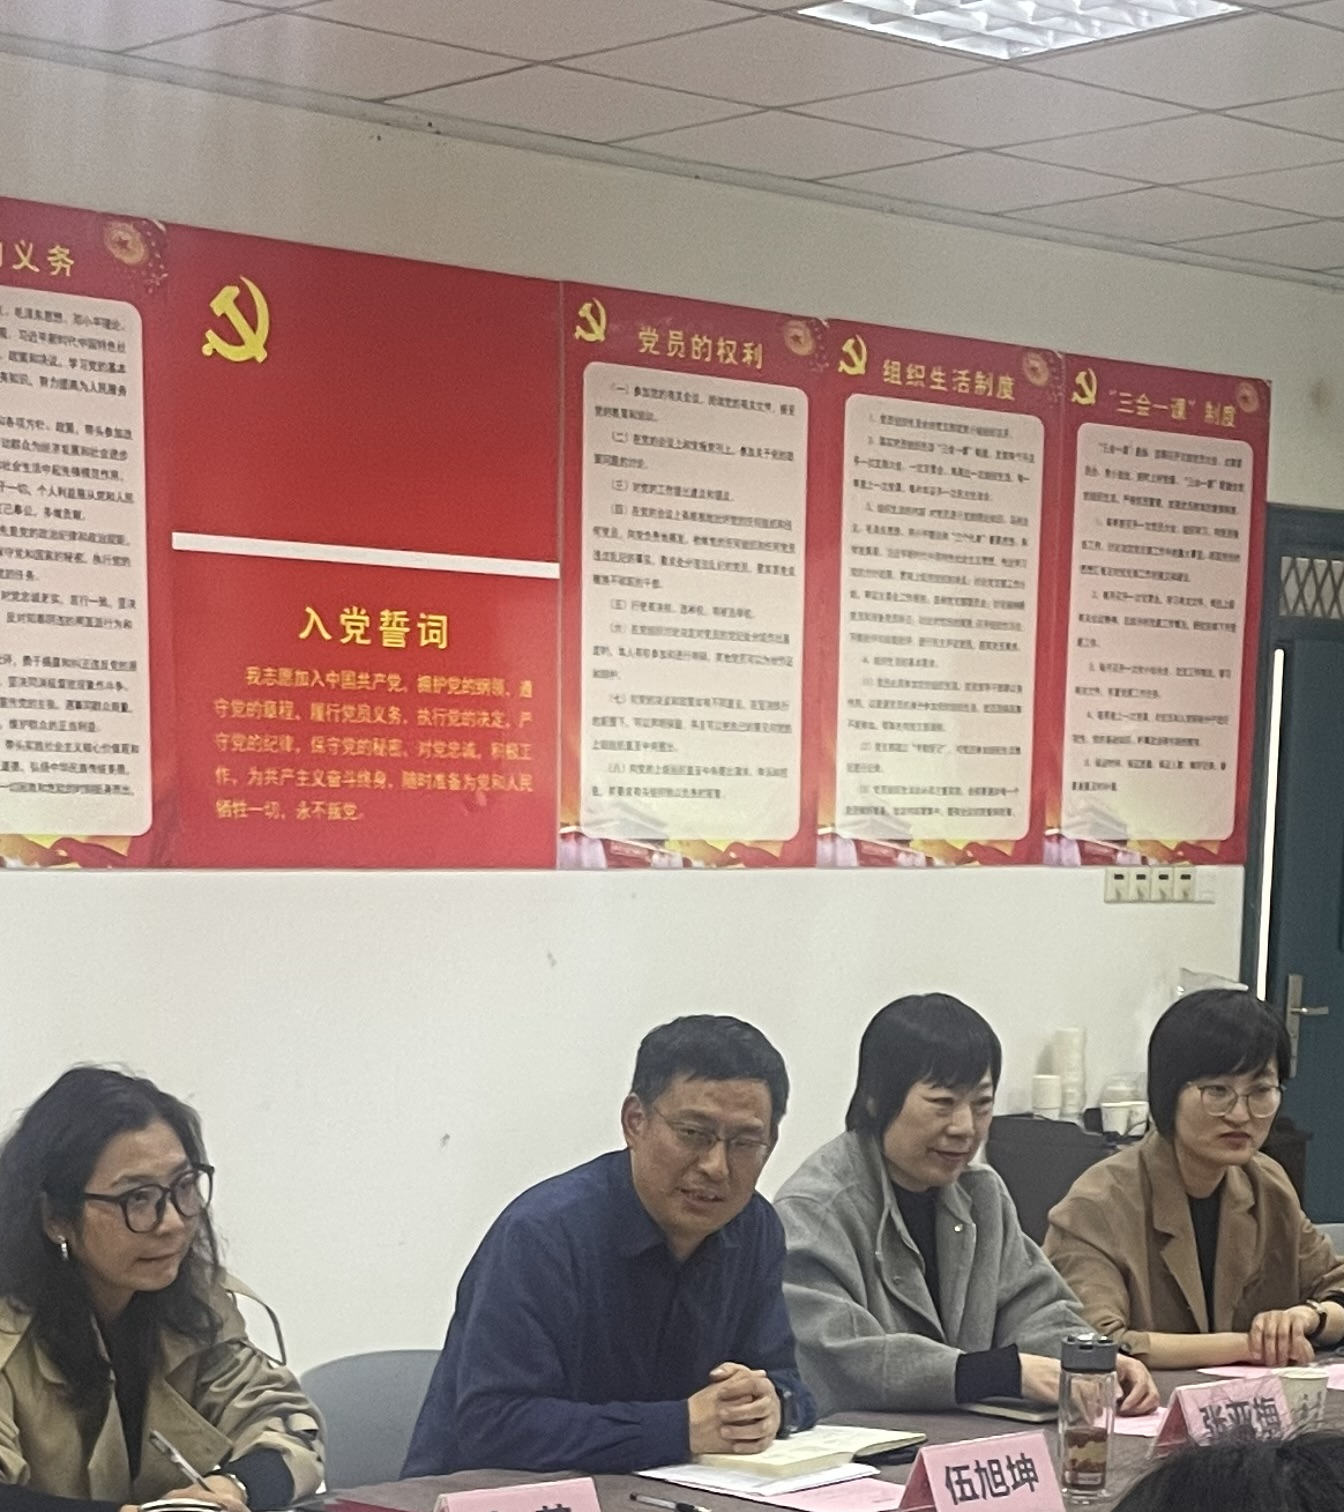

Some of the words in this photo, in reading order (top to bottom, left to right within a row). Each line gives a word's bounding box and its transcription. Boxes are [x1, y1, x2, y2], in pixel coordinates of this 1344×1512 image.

[637, 326, 765, 370] 党员的权利
[882, 358, 1016, 401] 组织生活制度
[297, 605, 450, 651] 入党誓词
[945, 1452, 1040, 1506] 伍旭坤
